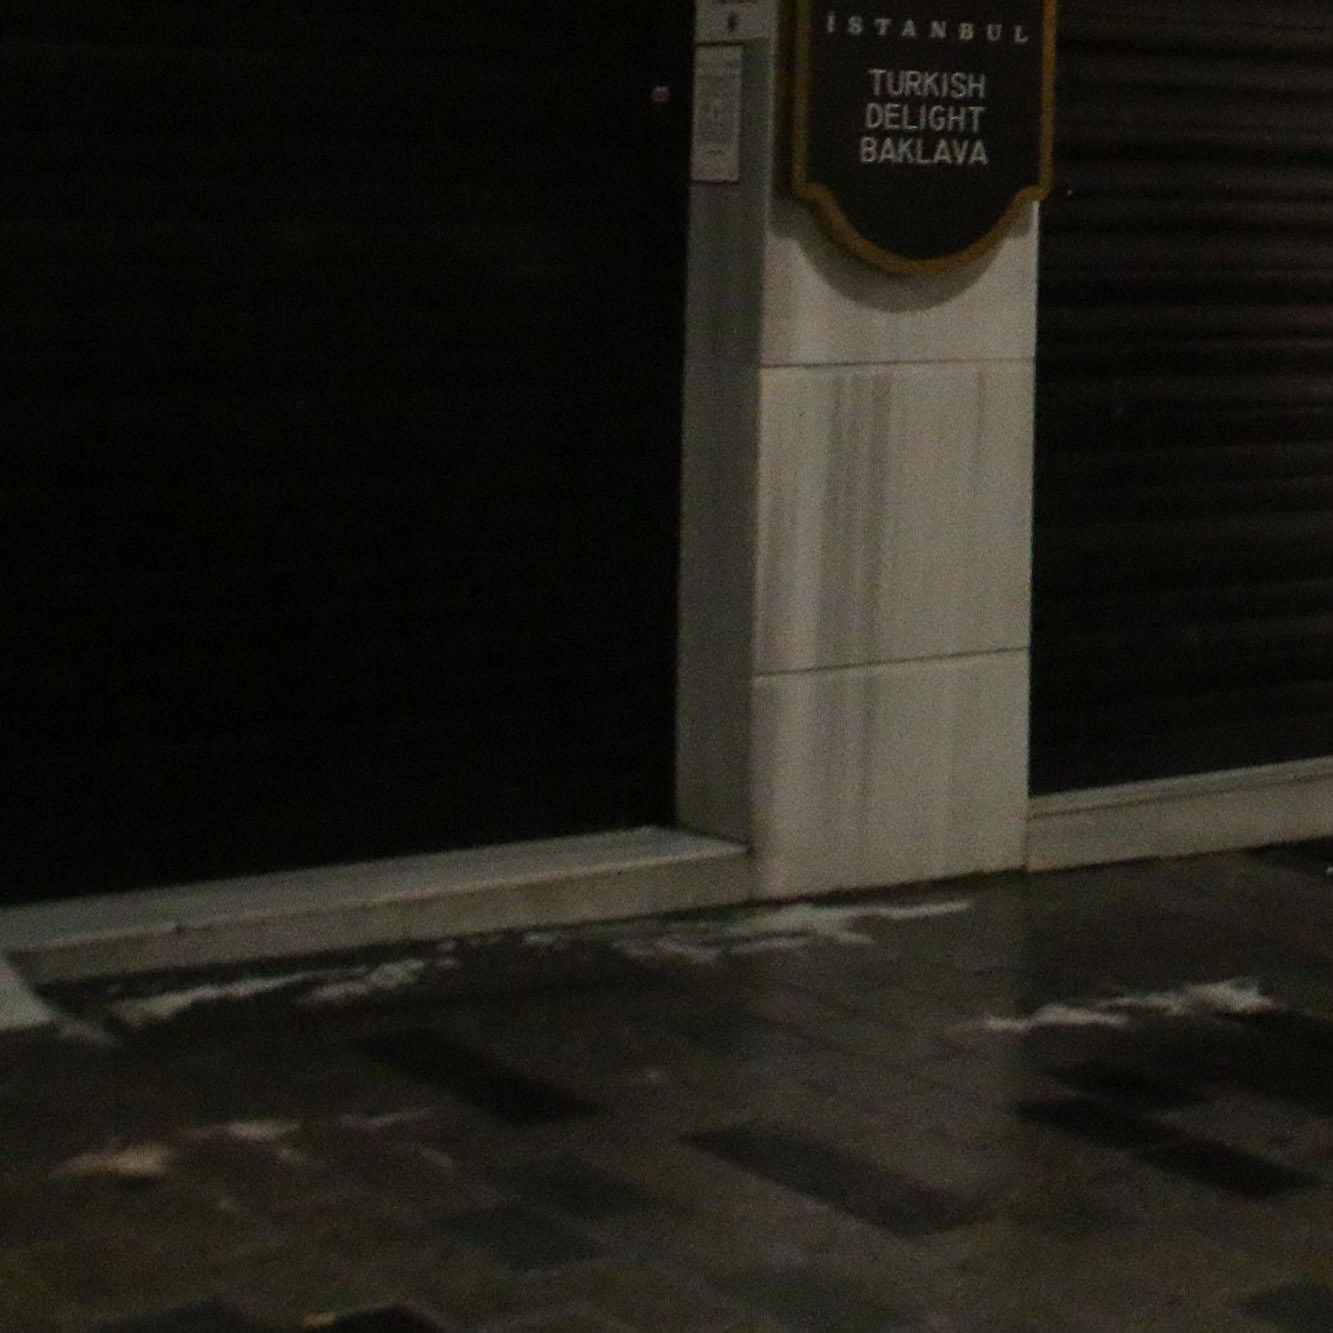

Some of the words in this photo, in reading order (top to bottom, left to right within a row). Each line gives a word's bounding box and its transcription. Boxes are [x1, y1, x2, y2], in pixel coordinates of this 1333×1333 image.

[867, 68, 987, 98] TURKISH
[865, 103, 987, 131] DELIGHT
[859, 136, 989, 165] BAKLAVA
